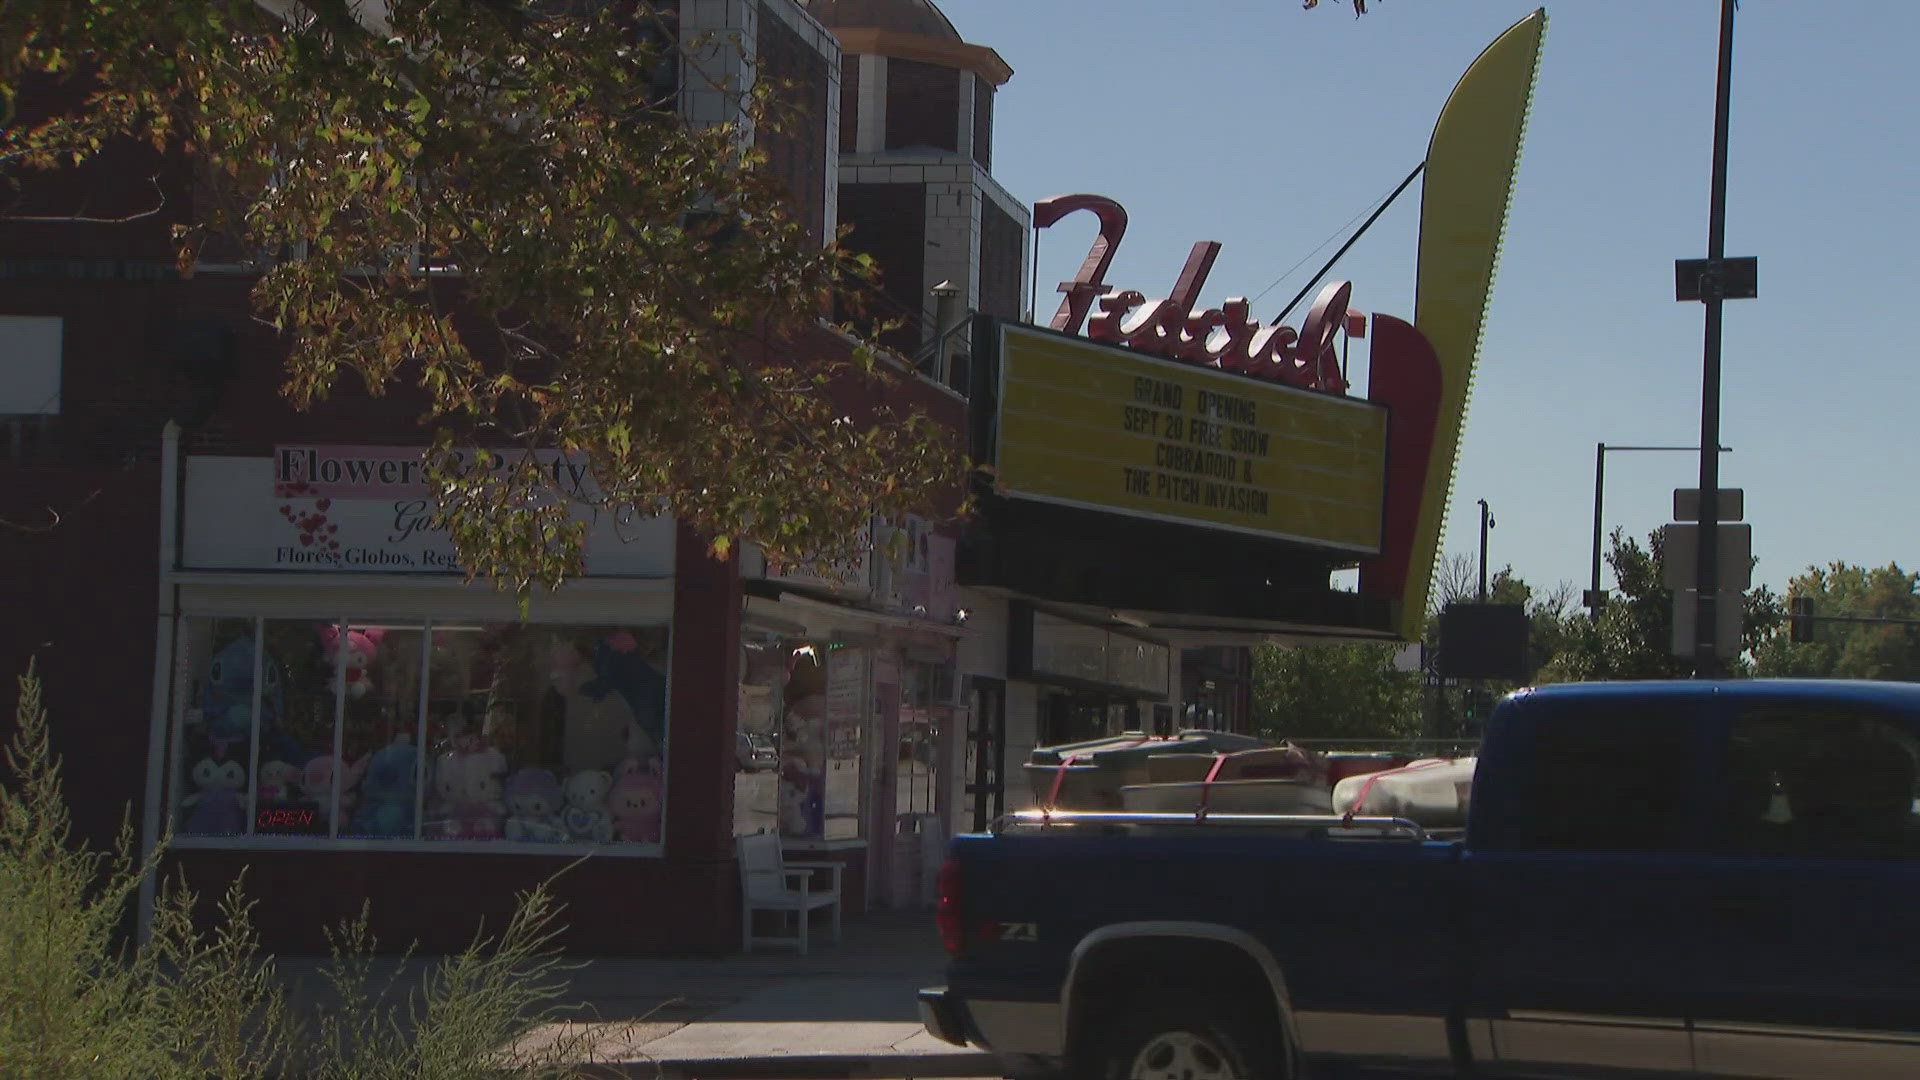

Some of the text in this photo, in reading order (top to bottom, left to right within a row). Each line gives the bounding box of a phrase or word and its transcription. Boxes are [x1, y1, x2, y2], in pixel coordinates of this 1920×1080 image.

[1033, 193, 1350, 396] Federal
[1134, 376, 1257, 426] GRAND OPENING
[1124, 405, 1269, 457] SEPT 20 FREE SHOW
[279, 449, 436, 485] Flowers
[483, 452, 586, 496] Pty
[1124, 467, 1269, 516] THE PITCH INVASION
[1244, 459, 1253, 484] &
[277, 547, 458, 569] Flores, Globos, Reg
[257, 807, 315, 828] OPEN
